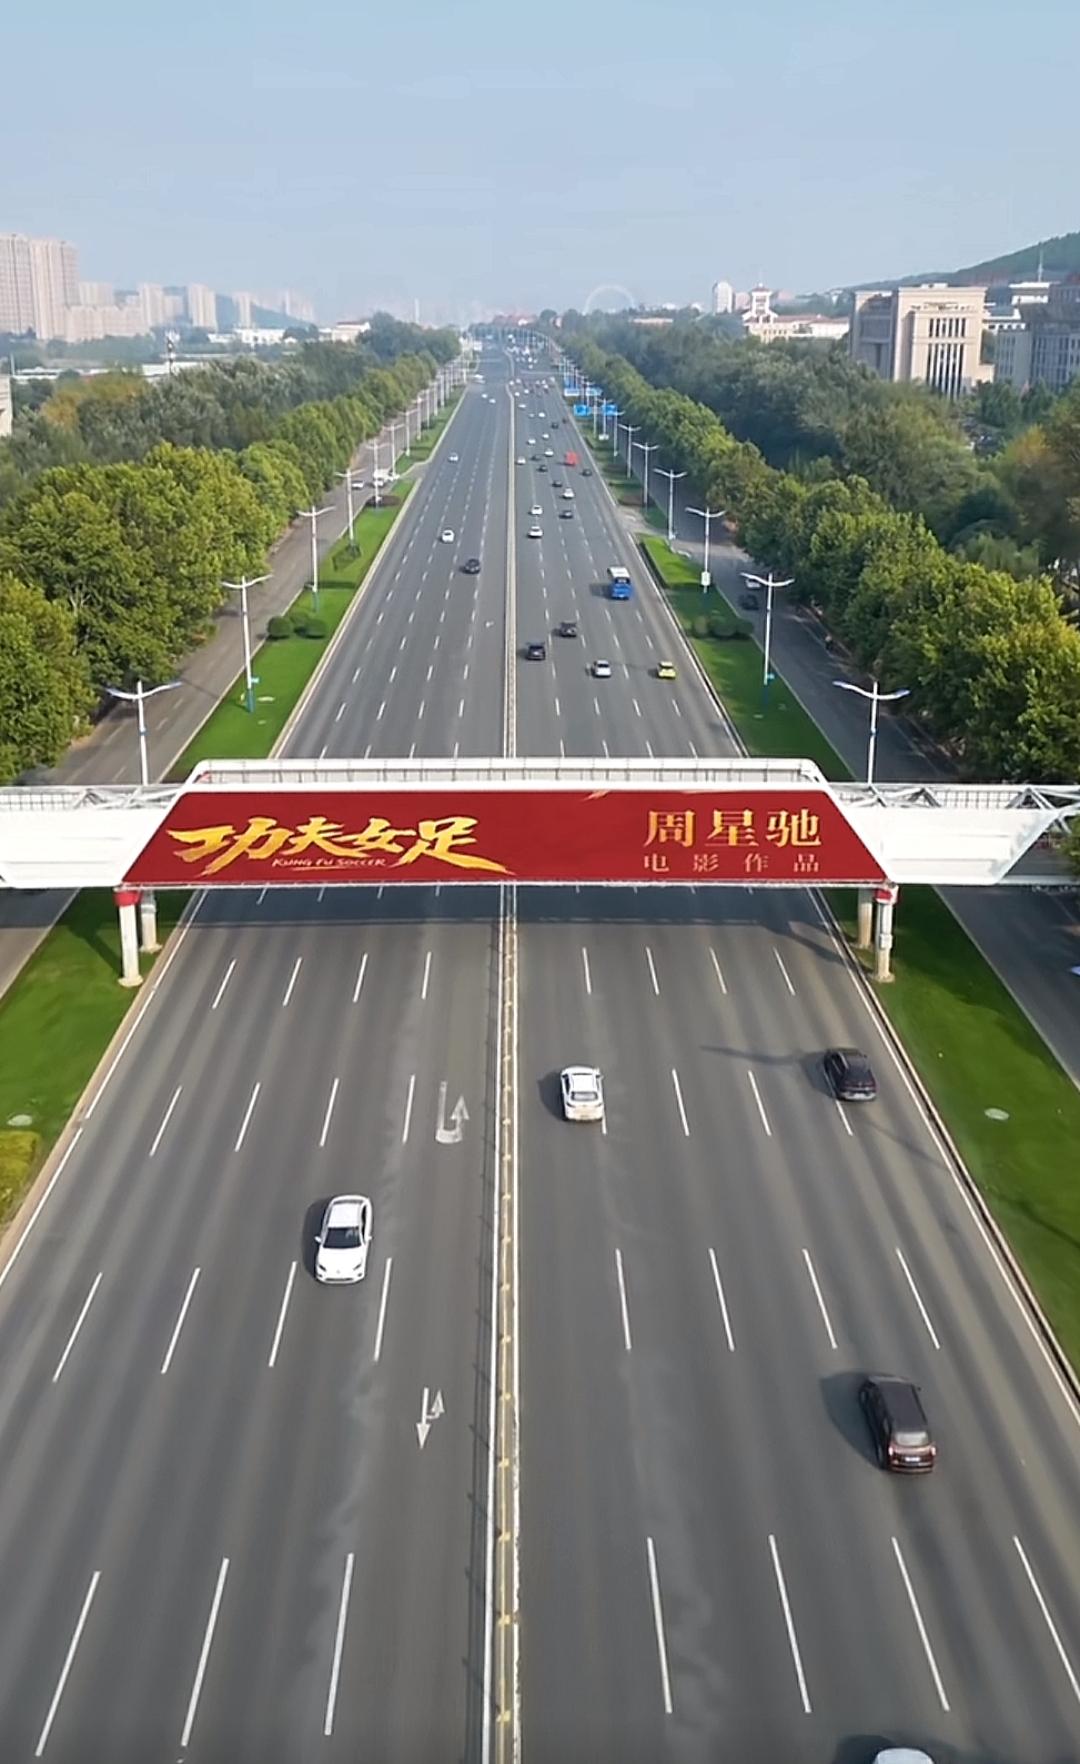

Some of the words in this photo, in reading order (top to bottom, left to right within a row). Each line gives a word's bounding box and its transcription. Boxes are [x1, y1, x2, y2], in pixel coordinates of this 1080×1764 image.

[643, 809, 822, 848] 周星驰
[167, 816, 516, 878] 功夫女足
[271, 858, 313, 868] KUNG
[315, 858, 334, 867] FU
[336, 858, 387, 867] SOCCER
[643, 853, 820, 873] 电影作品
